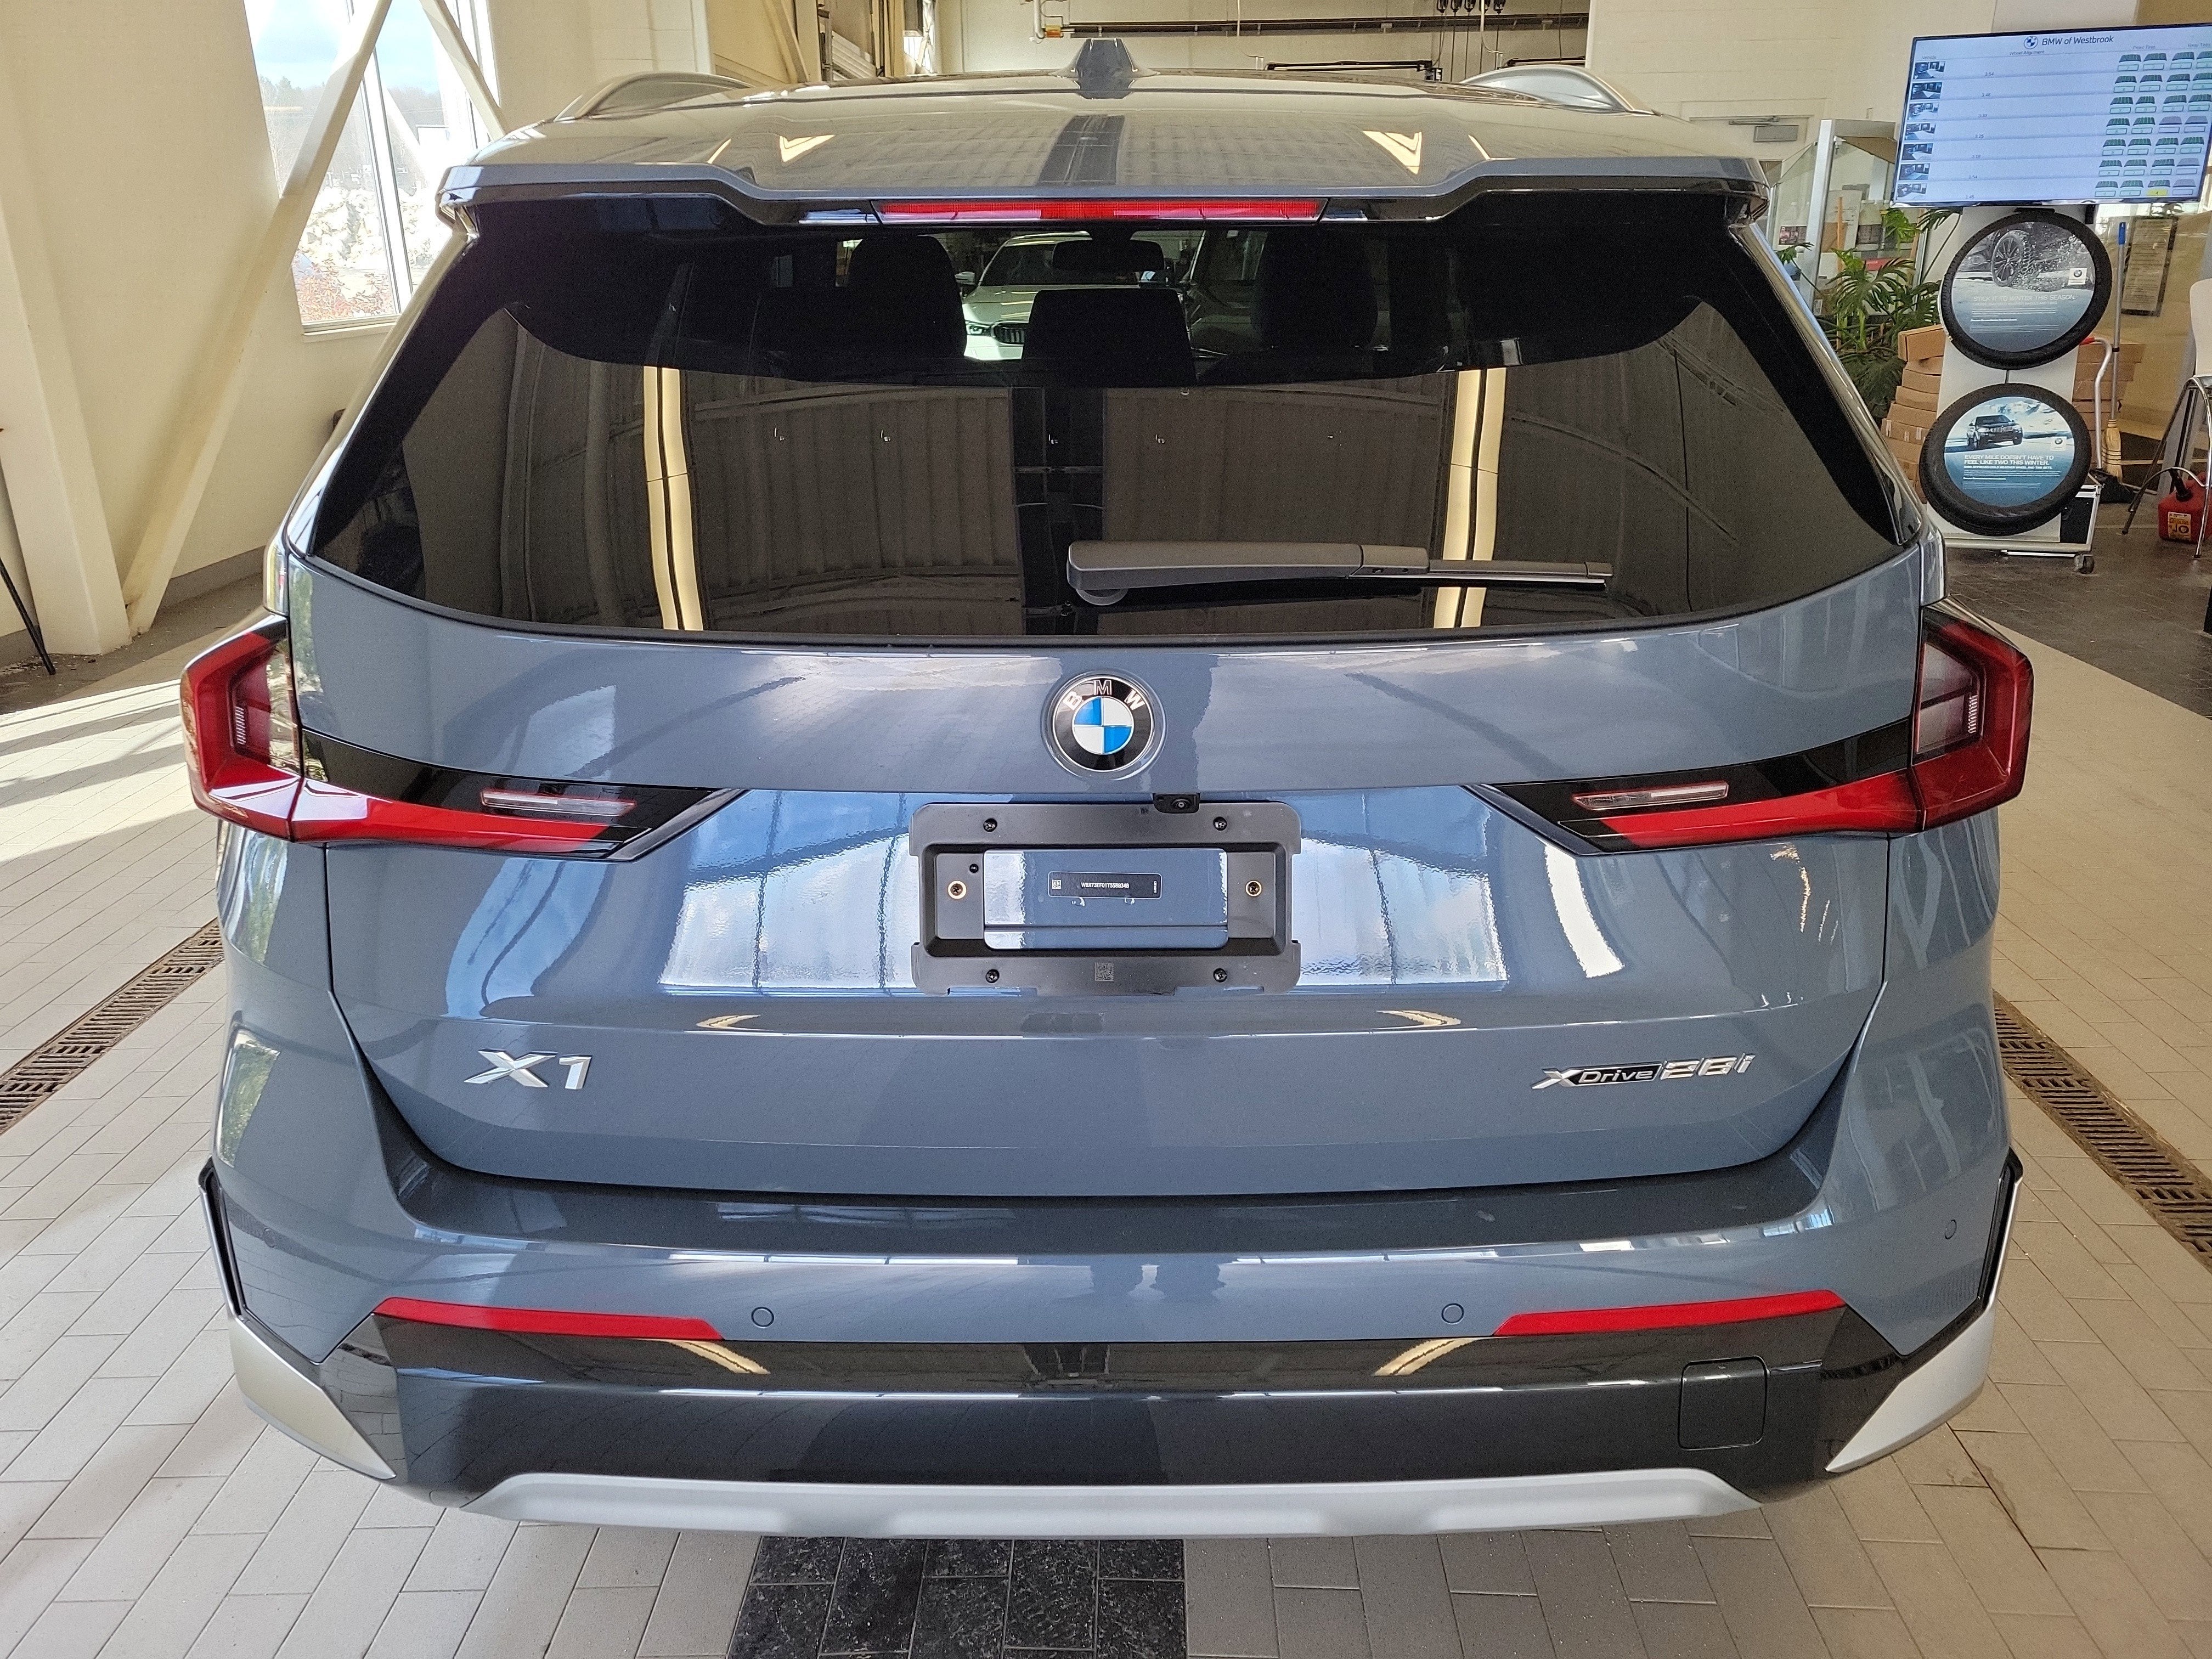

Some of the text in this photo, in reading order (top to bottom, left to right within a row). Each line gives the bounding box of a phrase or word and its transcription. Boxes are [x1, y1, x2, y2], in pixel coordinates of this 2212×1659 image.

[2042, 37, 2063, 46] BMW
[2074, 35, 2114, 44] Westbrook
[1062, 679, 1146, 711] BMW
[464, 1048, 592, 1090] X1
